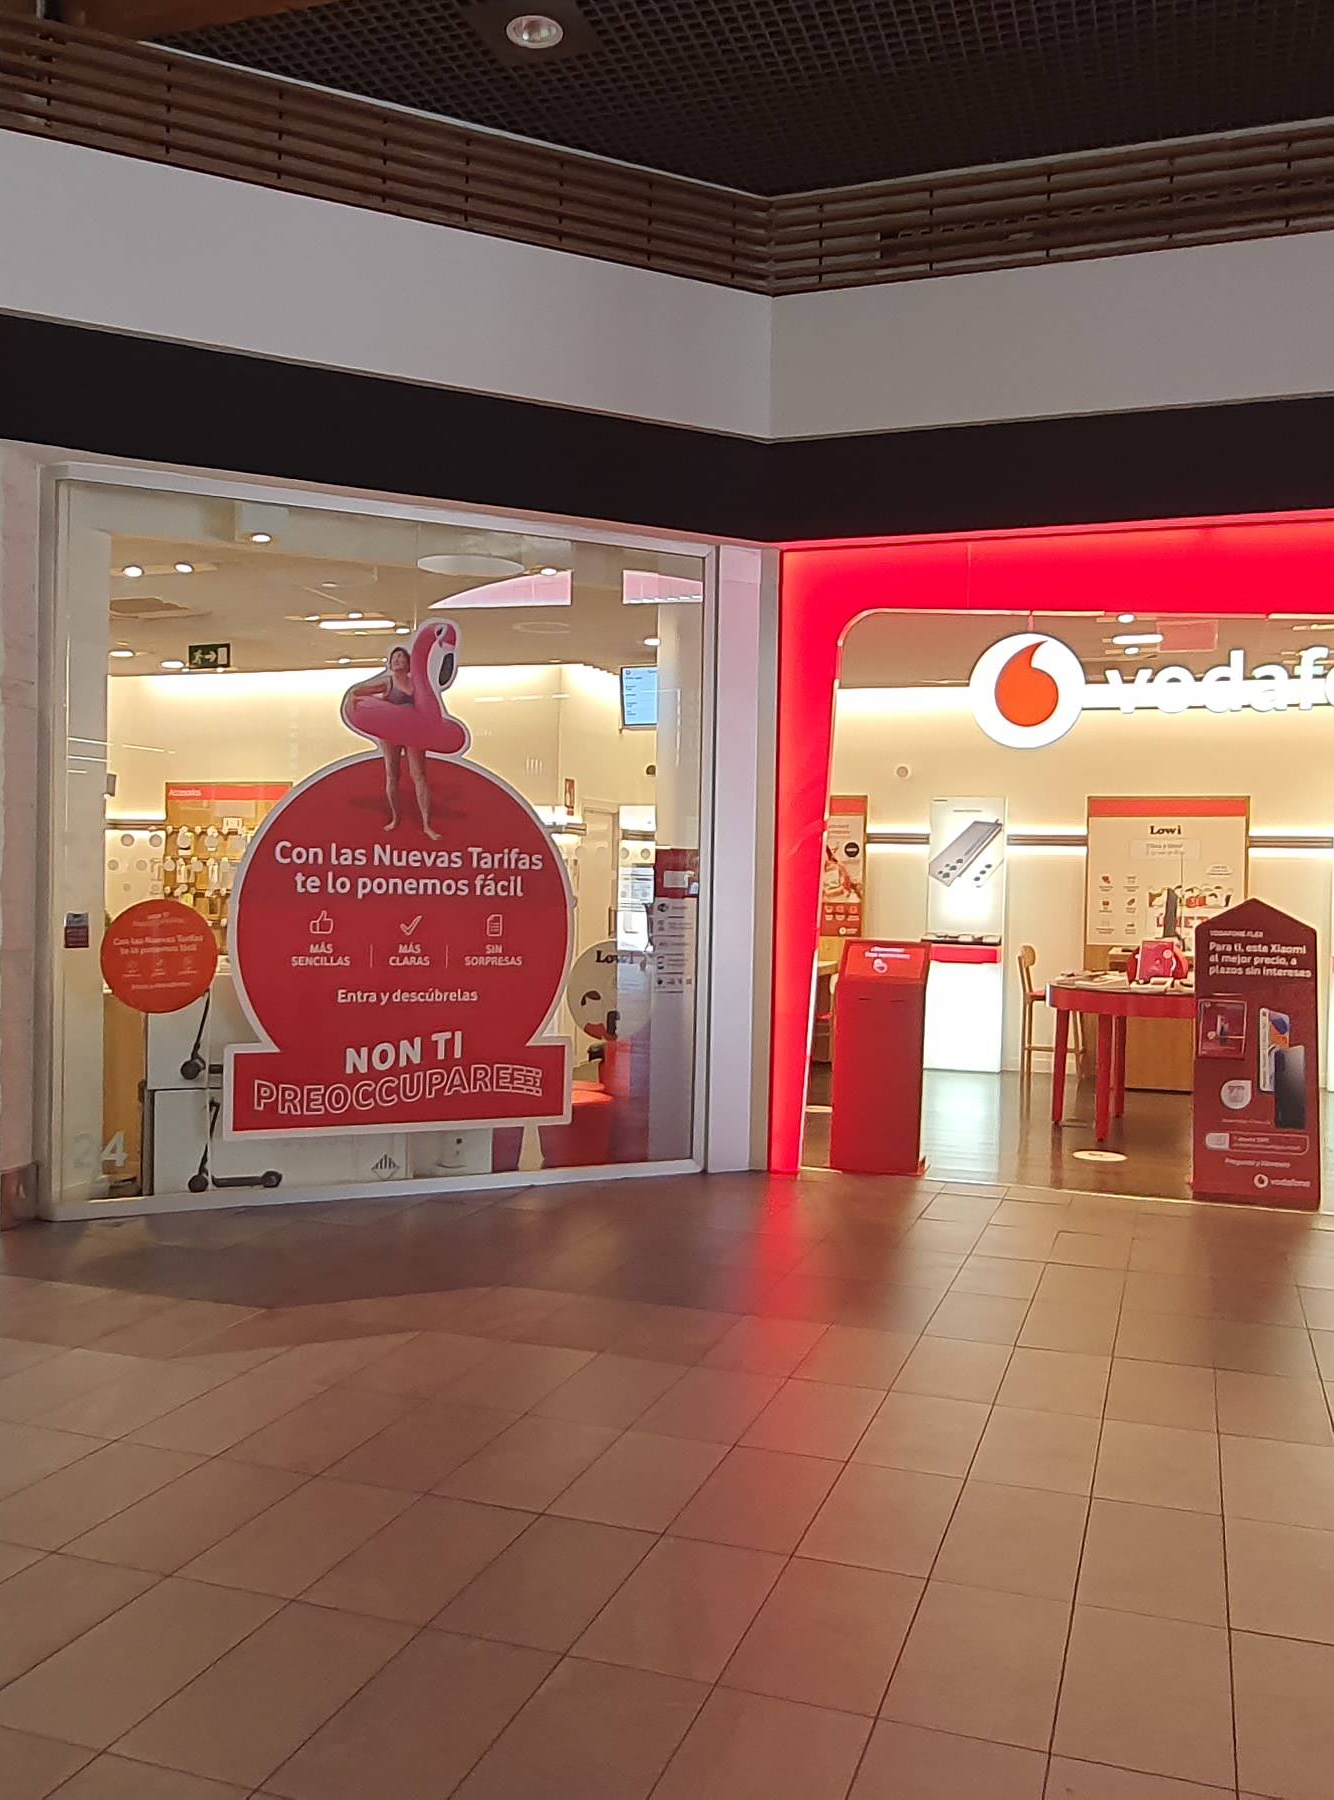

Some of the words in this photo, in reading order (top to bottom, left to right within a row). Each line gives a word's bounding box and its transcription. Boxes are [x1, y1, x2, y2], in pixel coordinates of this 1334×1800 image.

[1149, 824, 1182, 836] Lowi
[274, 840, 324, 865] Con
[330, 843, 367, 866] las
[373, 844, 463, 869] Nuevas
[467, 846, 544, 871] Tarifas
[294, 871, 321, 894] te
[327, 870, 351, 895] lo
[357, 876, 469, 900] ponemos
[474, 873, 524, 898] fácil
[309, 942, 334, 954] MÁS
[398, 942, 422, 954] MÁS
[485, 943, 503, 954] SIN
[1209, 941, 1233, 952] Para
[1245, 943, 1269, 953] este
[1270, 944, 1307, 955] Xiaomi
[290, 955, 351, 967] SENCILLAS
[388, 955, 431, 967] CLARAS
[464, 955, 523, 967] SORPRESAS
[1208, 953, 1220, 963] al
[1221, 954, 1252, 965] mejor
[1253, 955, 1289, 967] precio,
[1290, 957, 1298, 966] a
[1208, 965, 1244, 976] plazos
[1244, 966, 1262, 976] sin
[1262, 966, 1312, 978] intereses
[336, 988, 377, 1004] Entra
[380, 992, 388, 1006] y
[392, 987, 478, 1003] descúbrelas
[345, 1036, 422, 1074] NON
[430, 1030, 463, 1060] TI
